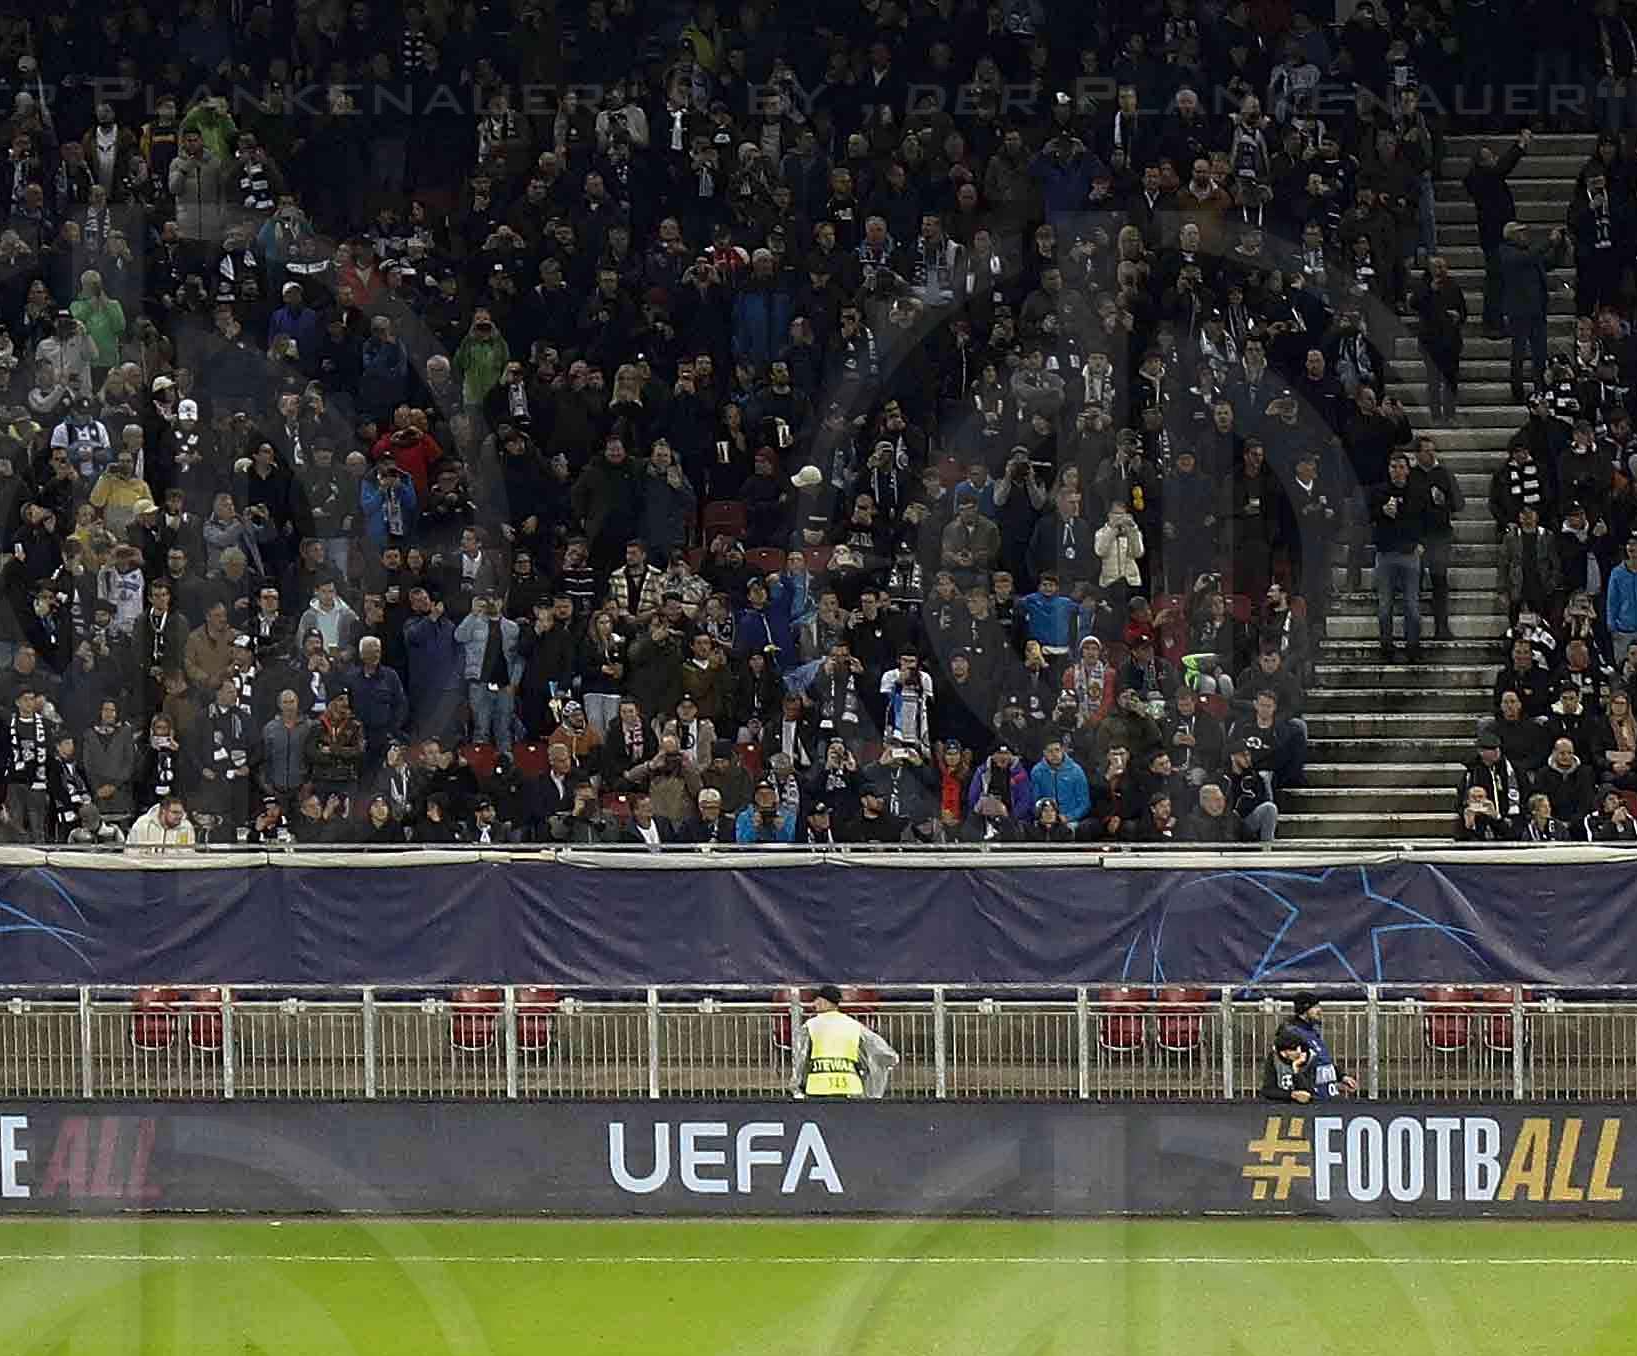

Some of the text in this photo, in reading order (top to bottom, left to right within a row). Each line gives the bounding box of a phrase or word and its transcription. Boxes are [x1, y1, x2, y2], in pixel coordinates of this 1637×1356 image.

[44, 1115, 163, 1199] ALL
[608, 1121, 845, 1194] UEFA
[1242, 1114, 1625, 1203] #FOOTBALL
